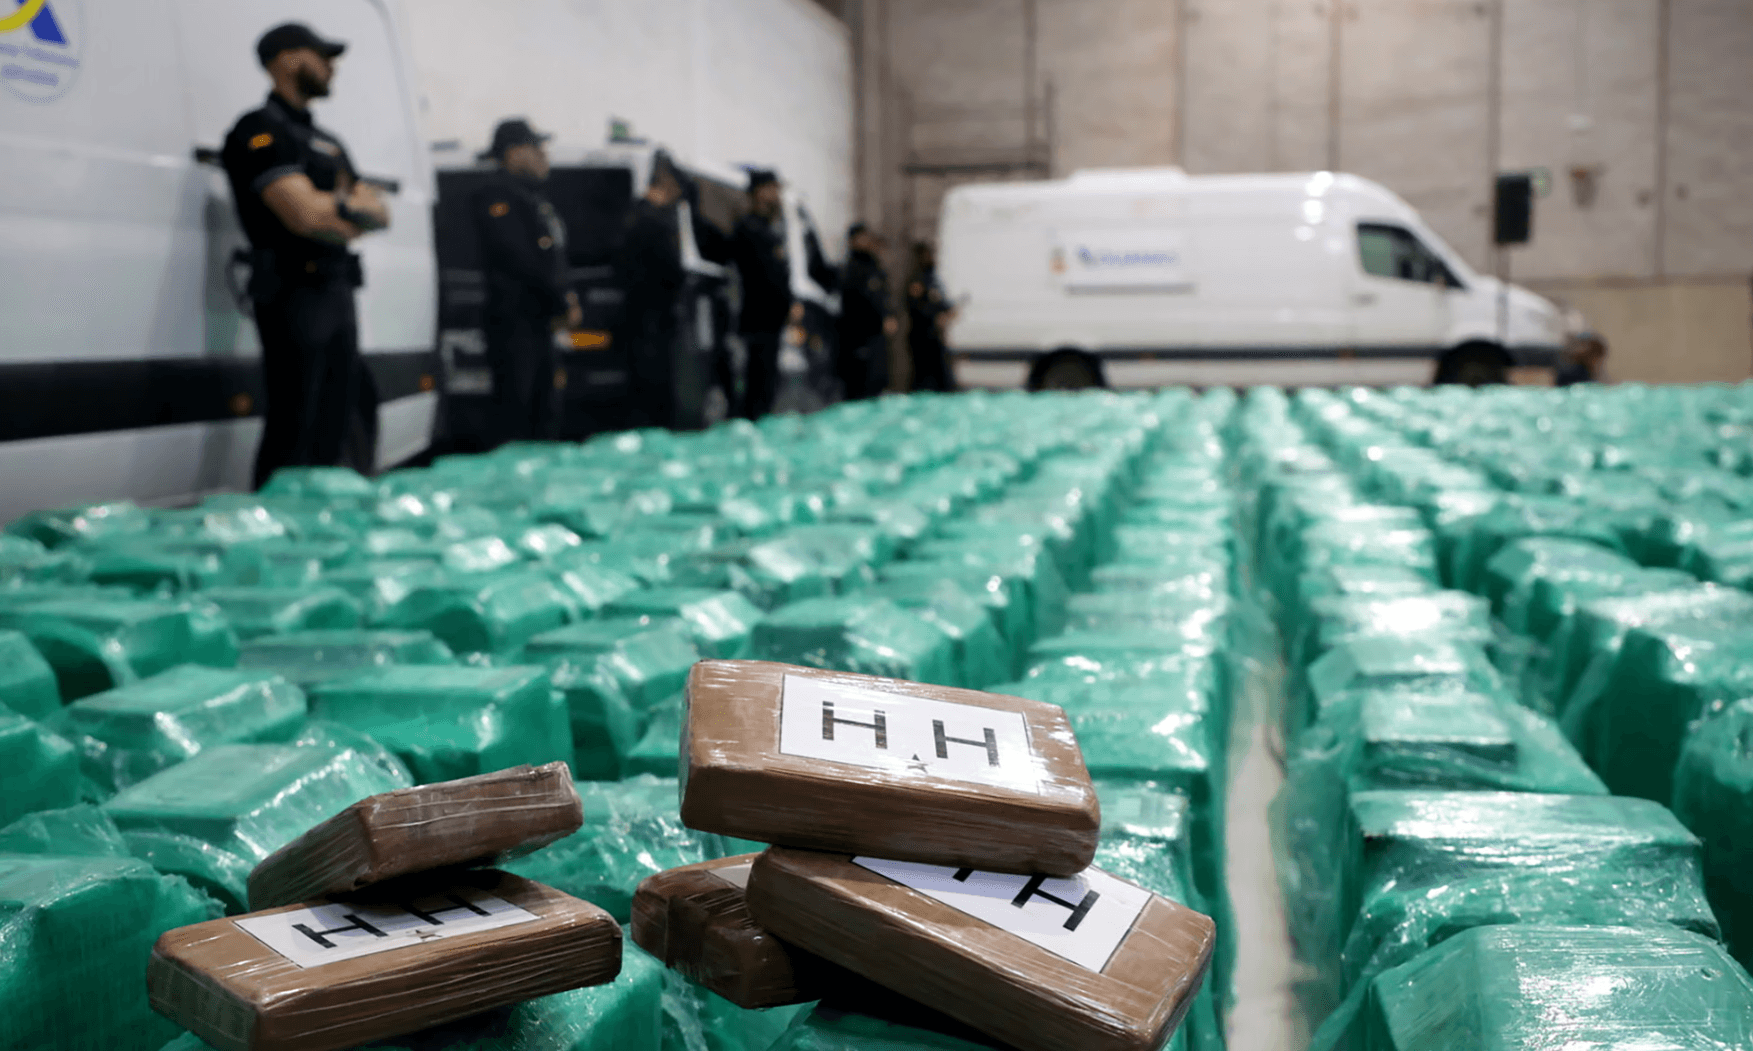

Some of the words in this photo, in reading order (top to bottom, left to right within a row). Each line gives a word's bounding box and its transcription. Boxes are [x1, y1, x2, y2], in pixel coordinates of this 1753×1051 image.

[823, 701, 887, 749] H
[932, 719, 1000, 767] H
[291, 914, 389, 949] H
